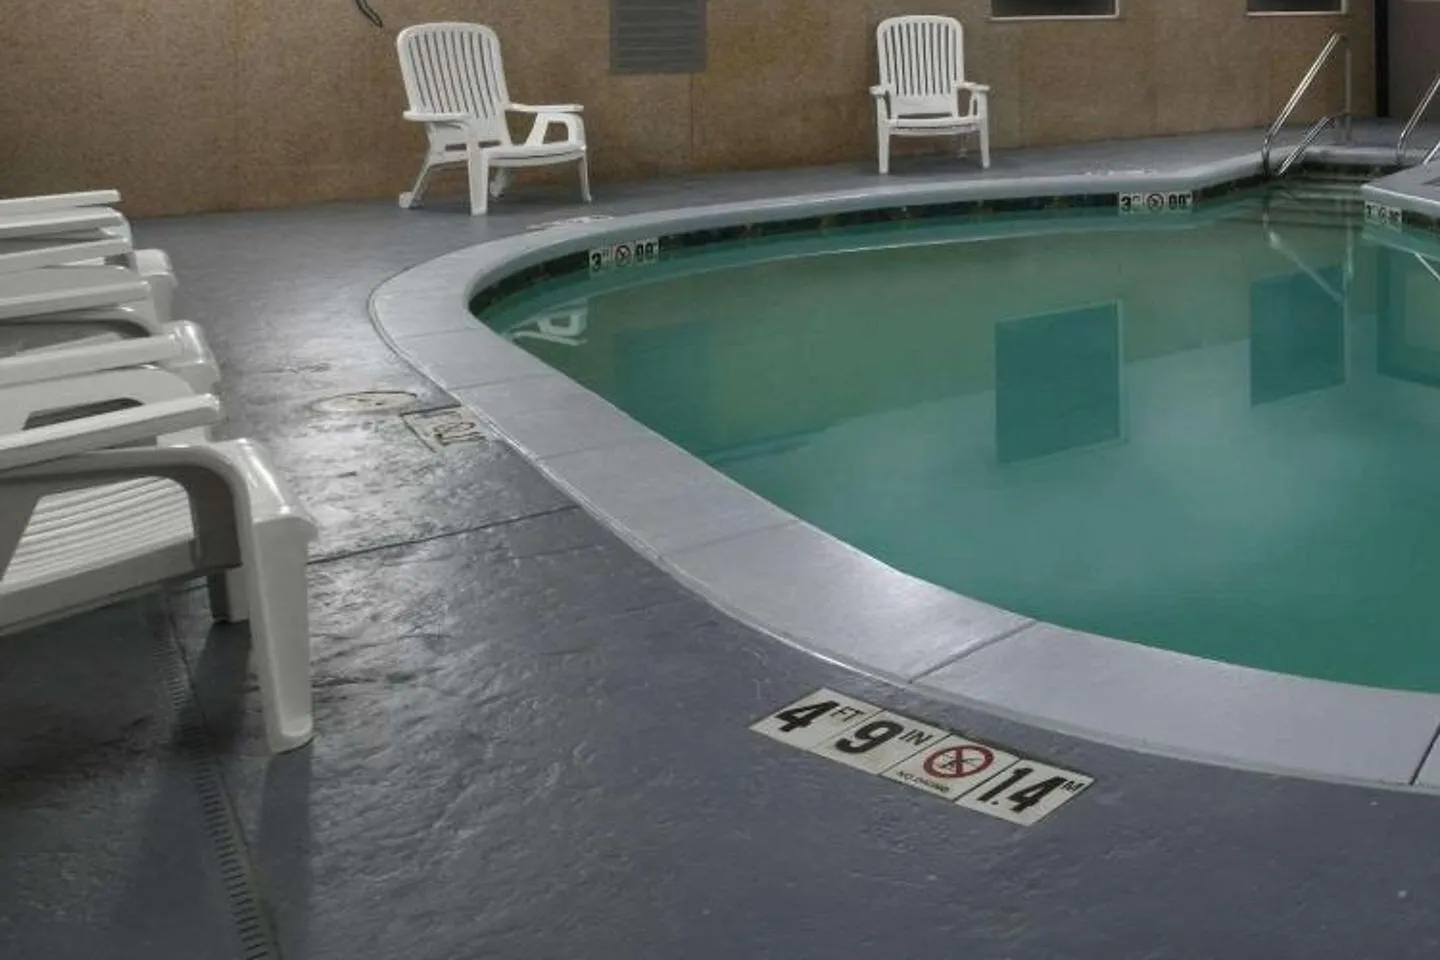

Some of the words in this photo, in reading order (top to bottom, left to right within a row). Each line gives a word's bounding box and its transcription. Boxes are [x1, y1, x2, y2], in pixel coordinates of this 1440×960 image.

[774, 700, 839, 733] 4
[829, 705, 867, 723] FT
[834, 720, 905, 755] 9
[899, 728, 934, 747] IN
